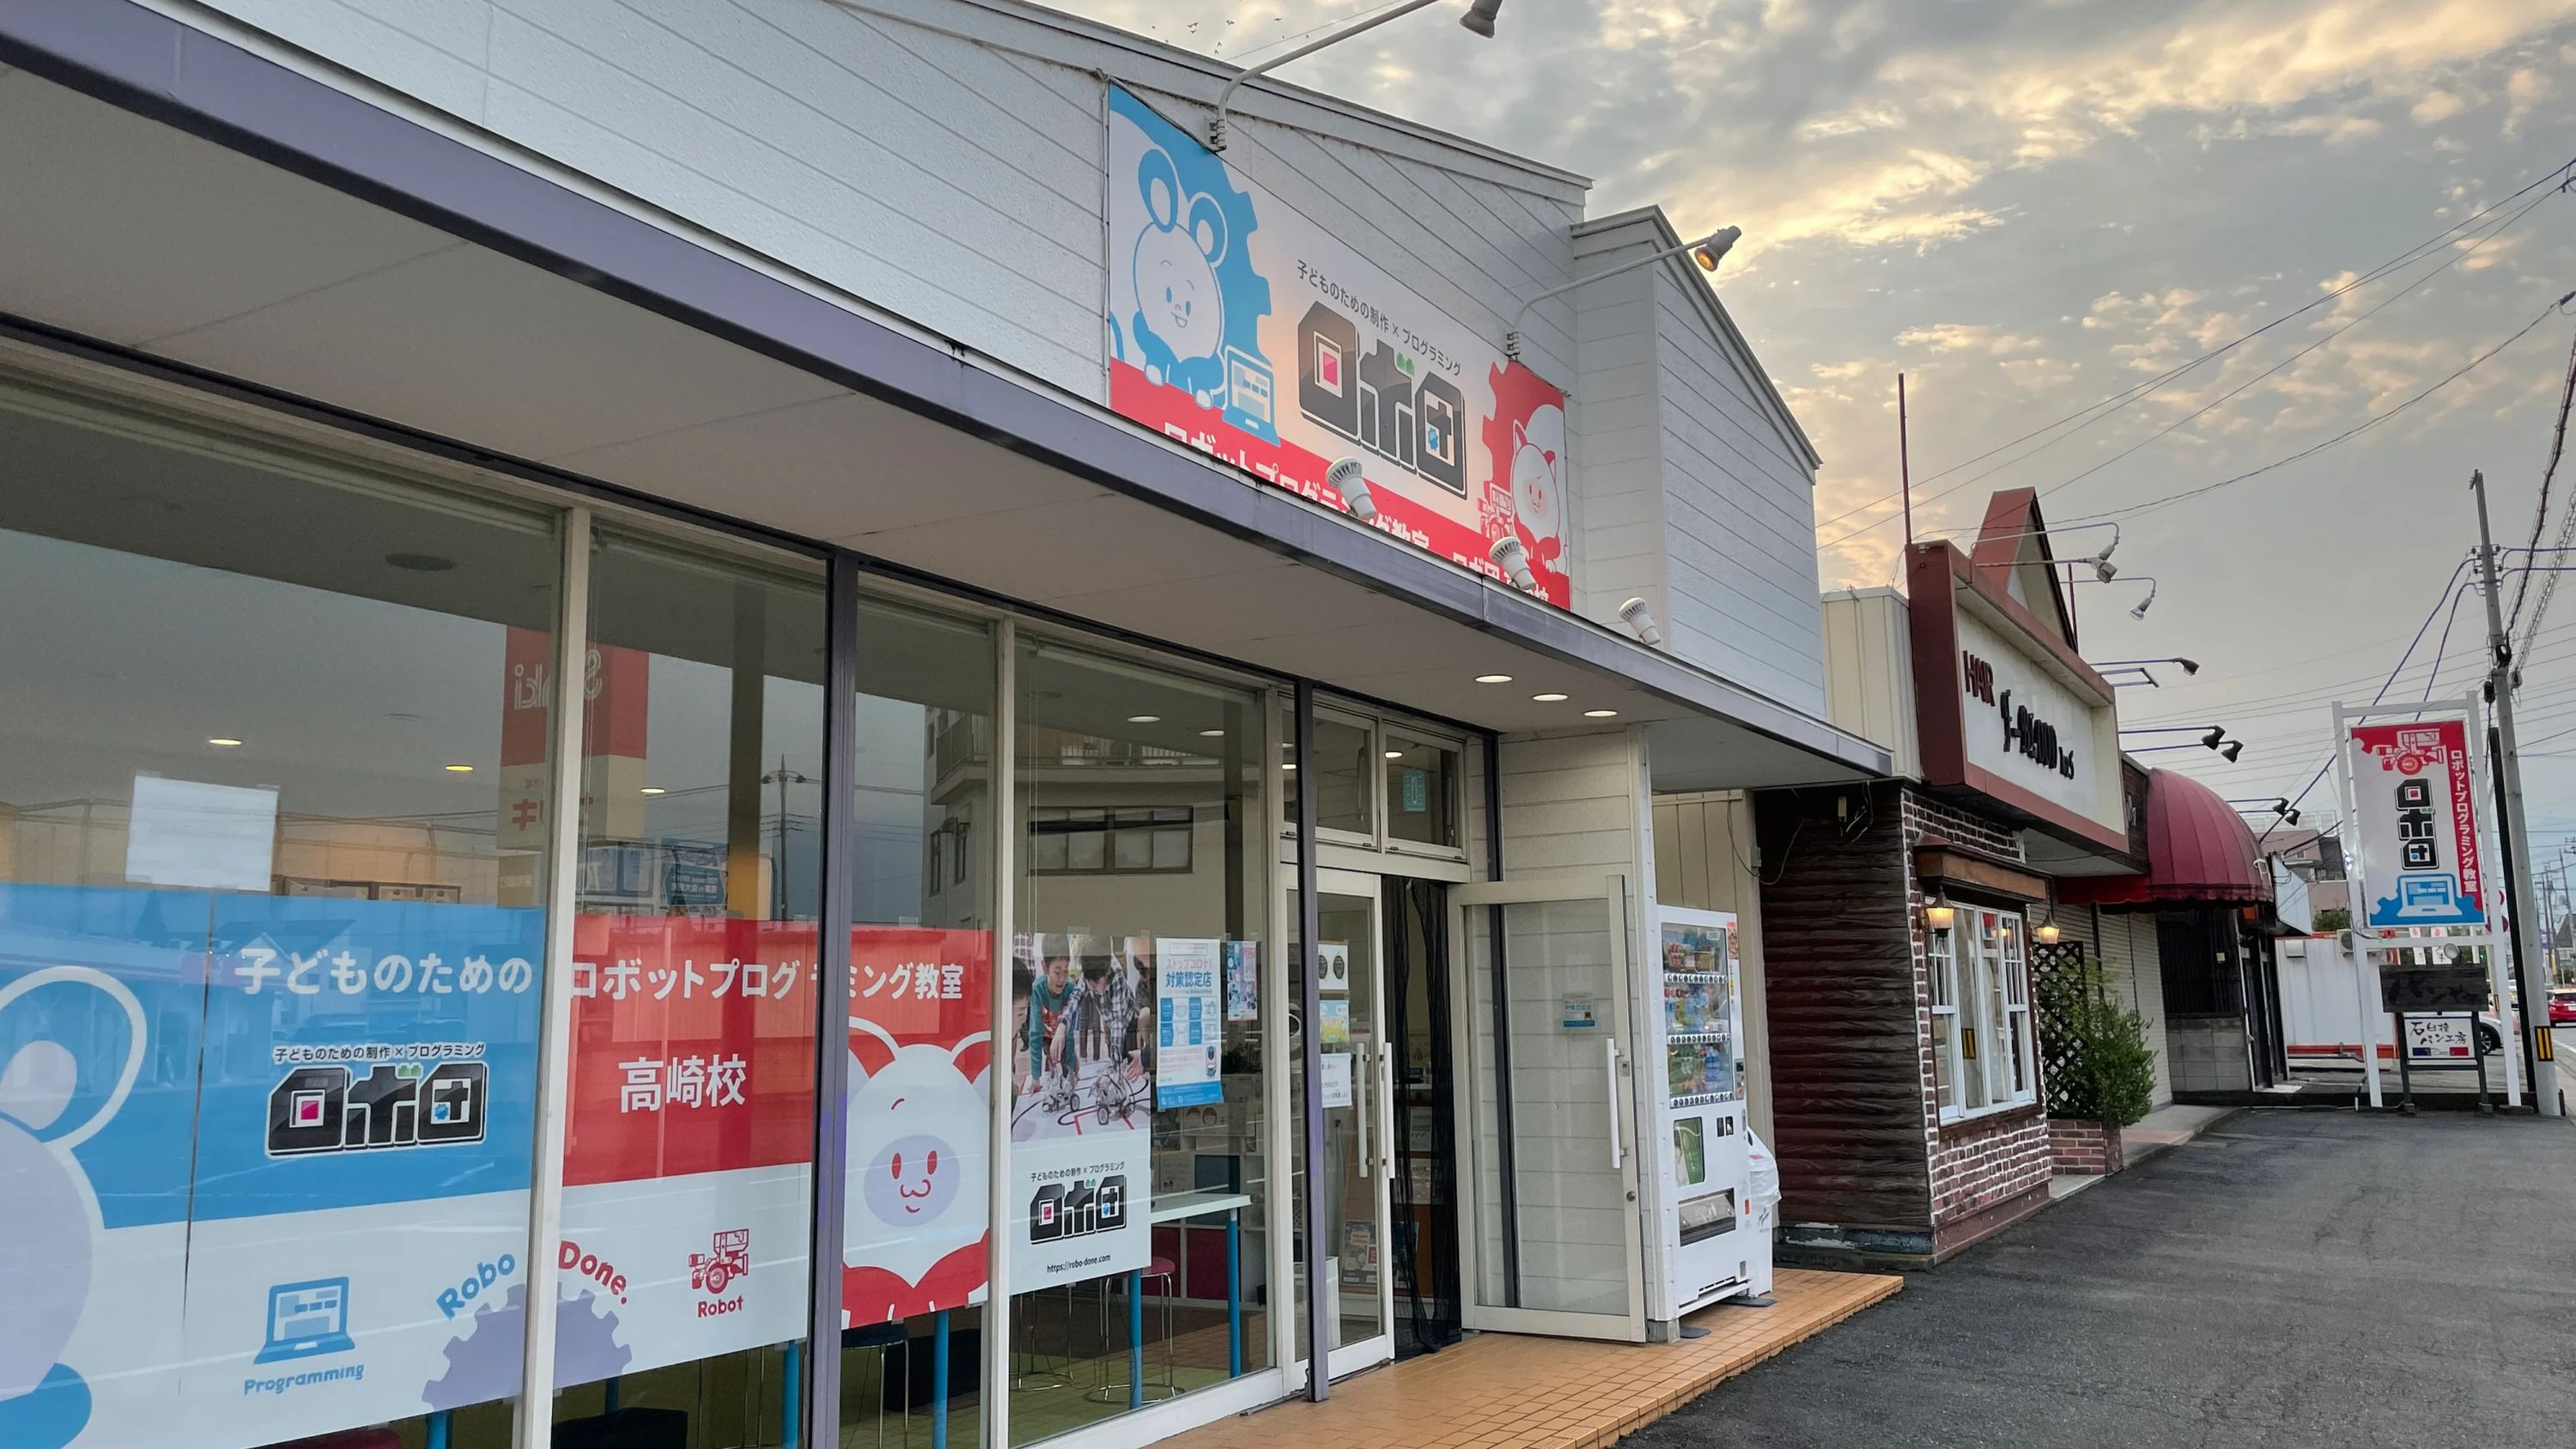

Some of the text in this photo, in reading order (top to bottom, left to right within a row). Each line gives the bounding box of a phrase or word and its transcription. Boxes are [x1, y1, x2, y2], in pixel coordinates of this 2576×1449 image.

[234, 947, 532, 995] 子どものための
[618, 1053, 747, 1113] 高崎校
[1046, 1254, 1112, 1274] https://robo-done.com
[435, 1253, 516, 1321] Robo
[697, 1294, 744, 1318] Robot
[243, 1363, 365, 1396] Programming
